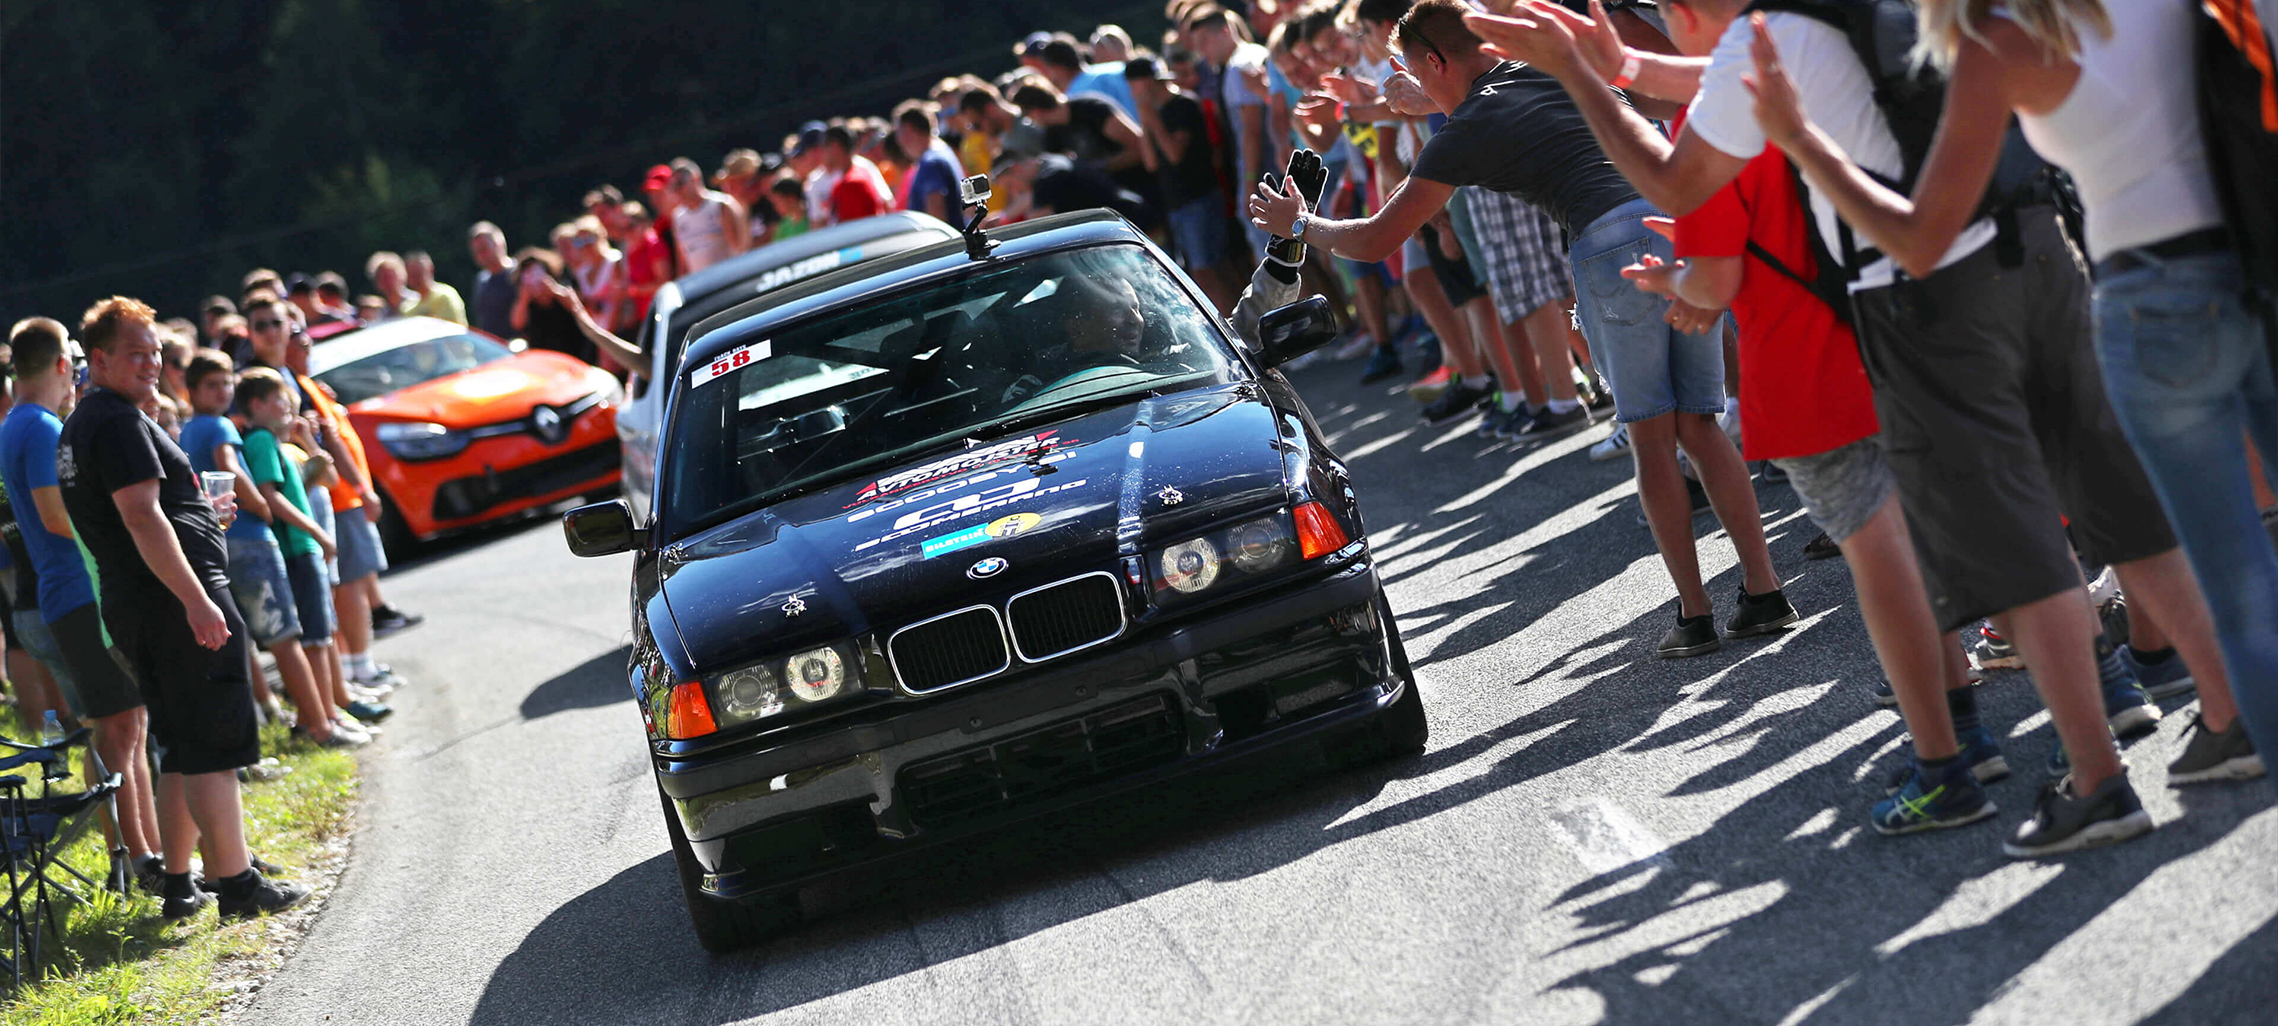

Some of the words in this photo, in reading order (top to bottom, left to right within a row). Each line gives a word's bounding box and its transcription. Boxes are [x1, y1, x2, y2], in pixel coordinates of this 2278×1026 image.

[712, 350, 750, 376] 58
[857, 437, 1060, 501] AVTOMOJSTER
[925, 528, 986, 552] BILSTEIN
